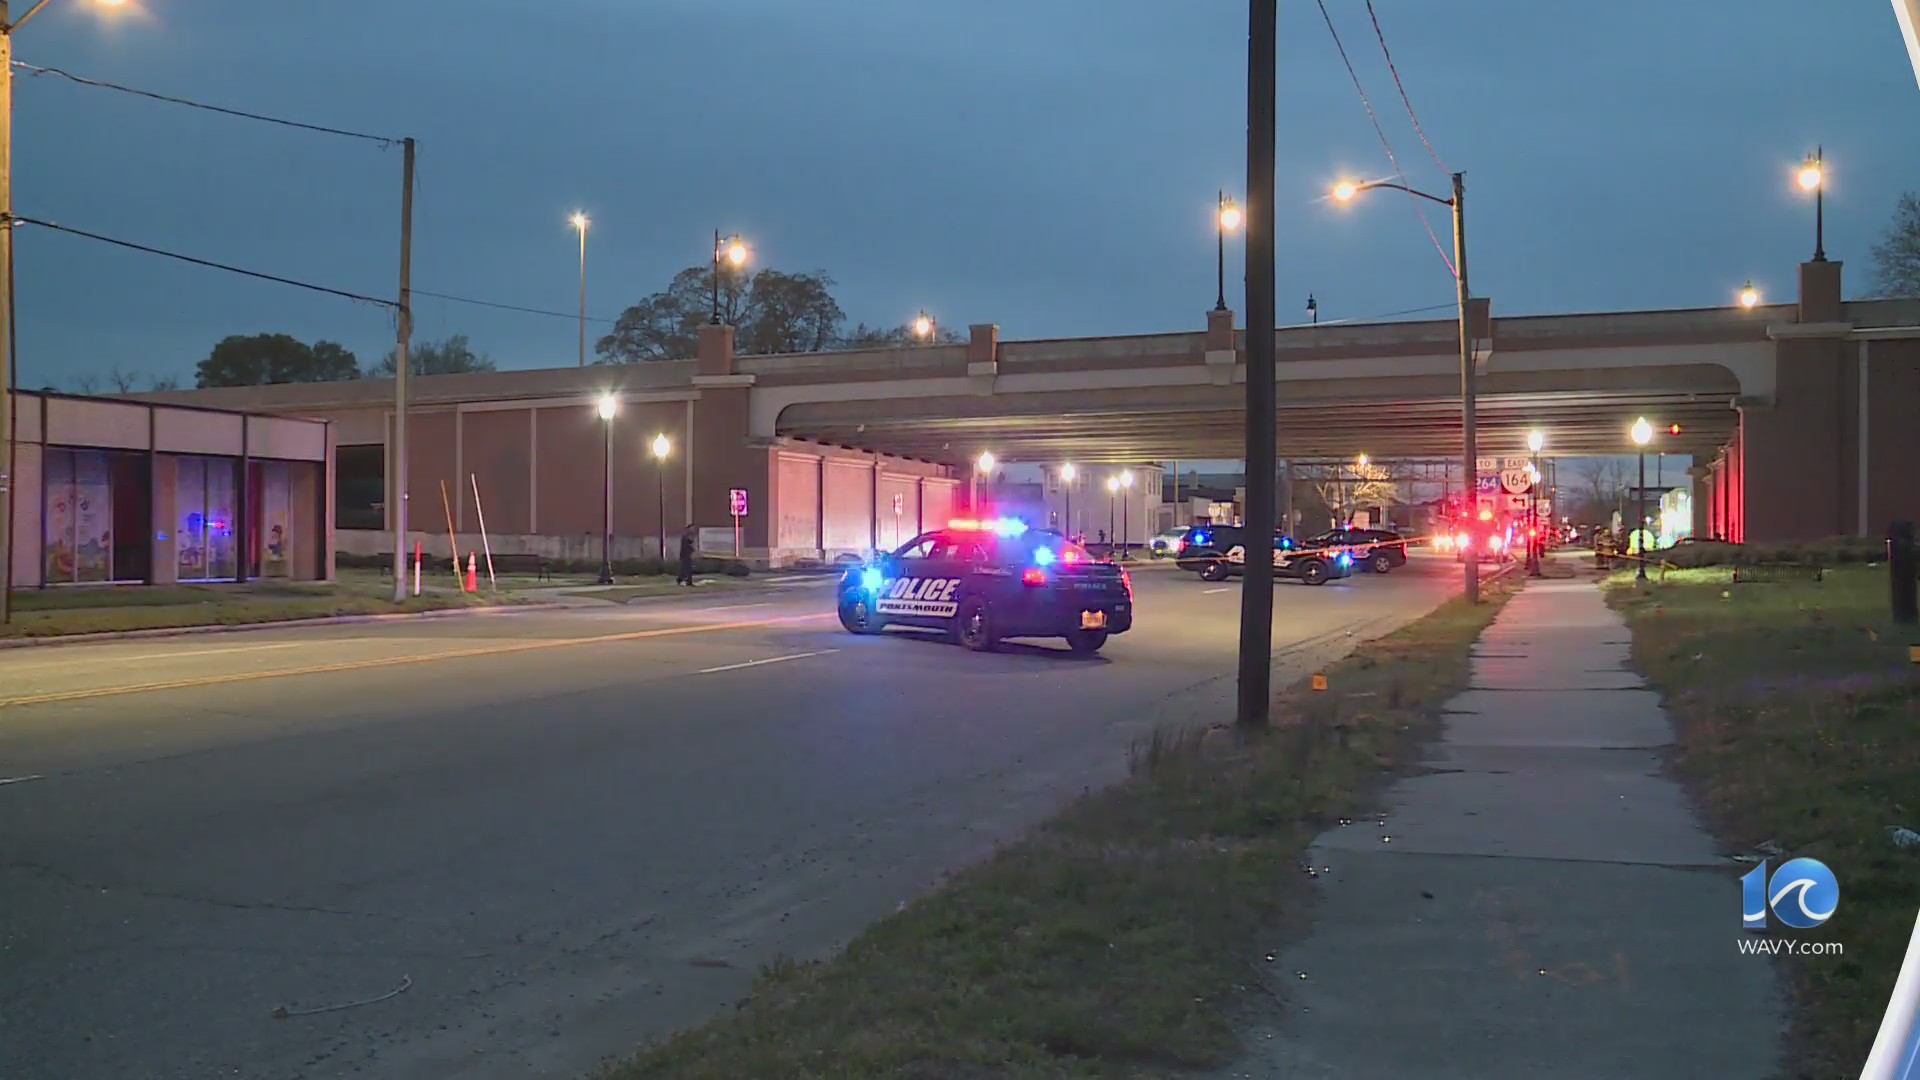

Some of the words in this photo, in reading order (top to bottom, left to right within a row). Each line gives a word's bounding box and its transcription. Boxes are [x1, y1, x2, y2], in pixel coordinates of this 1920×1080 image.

[1507, 459, 1525, 467] EAST
[1476, 477, 1498, 490] 264
[1505, 473, 1528, 486] 164
[879, 577, 961, 601] POLICE
[880, 602, 953, 613] PORTSMOUTH
